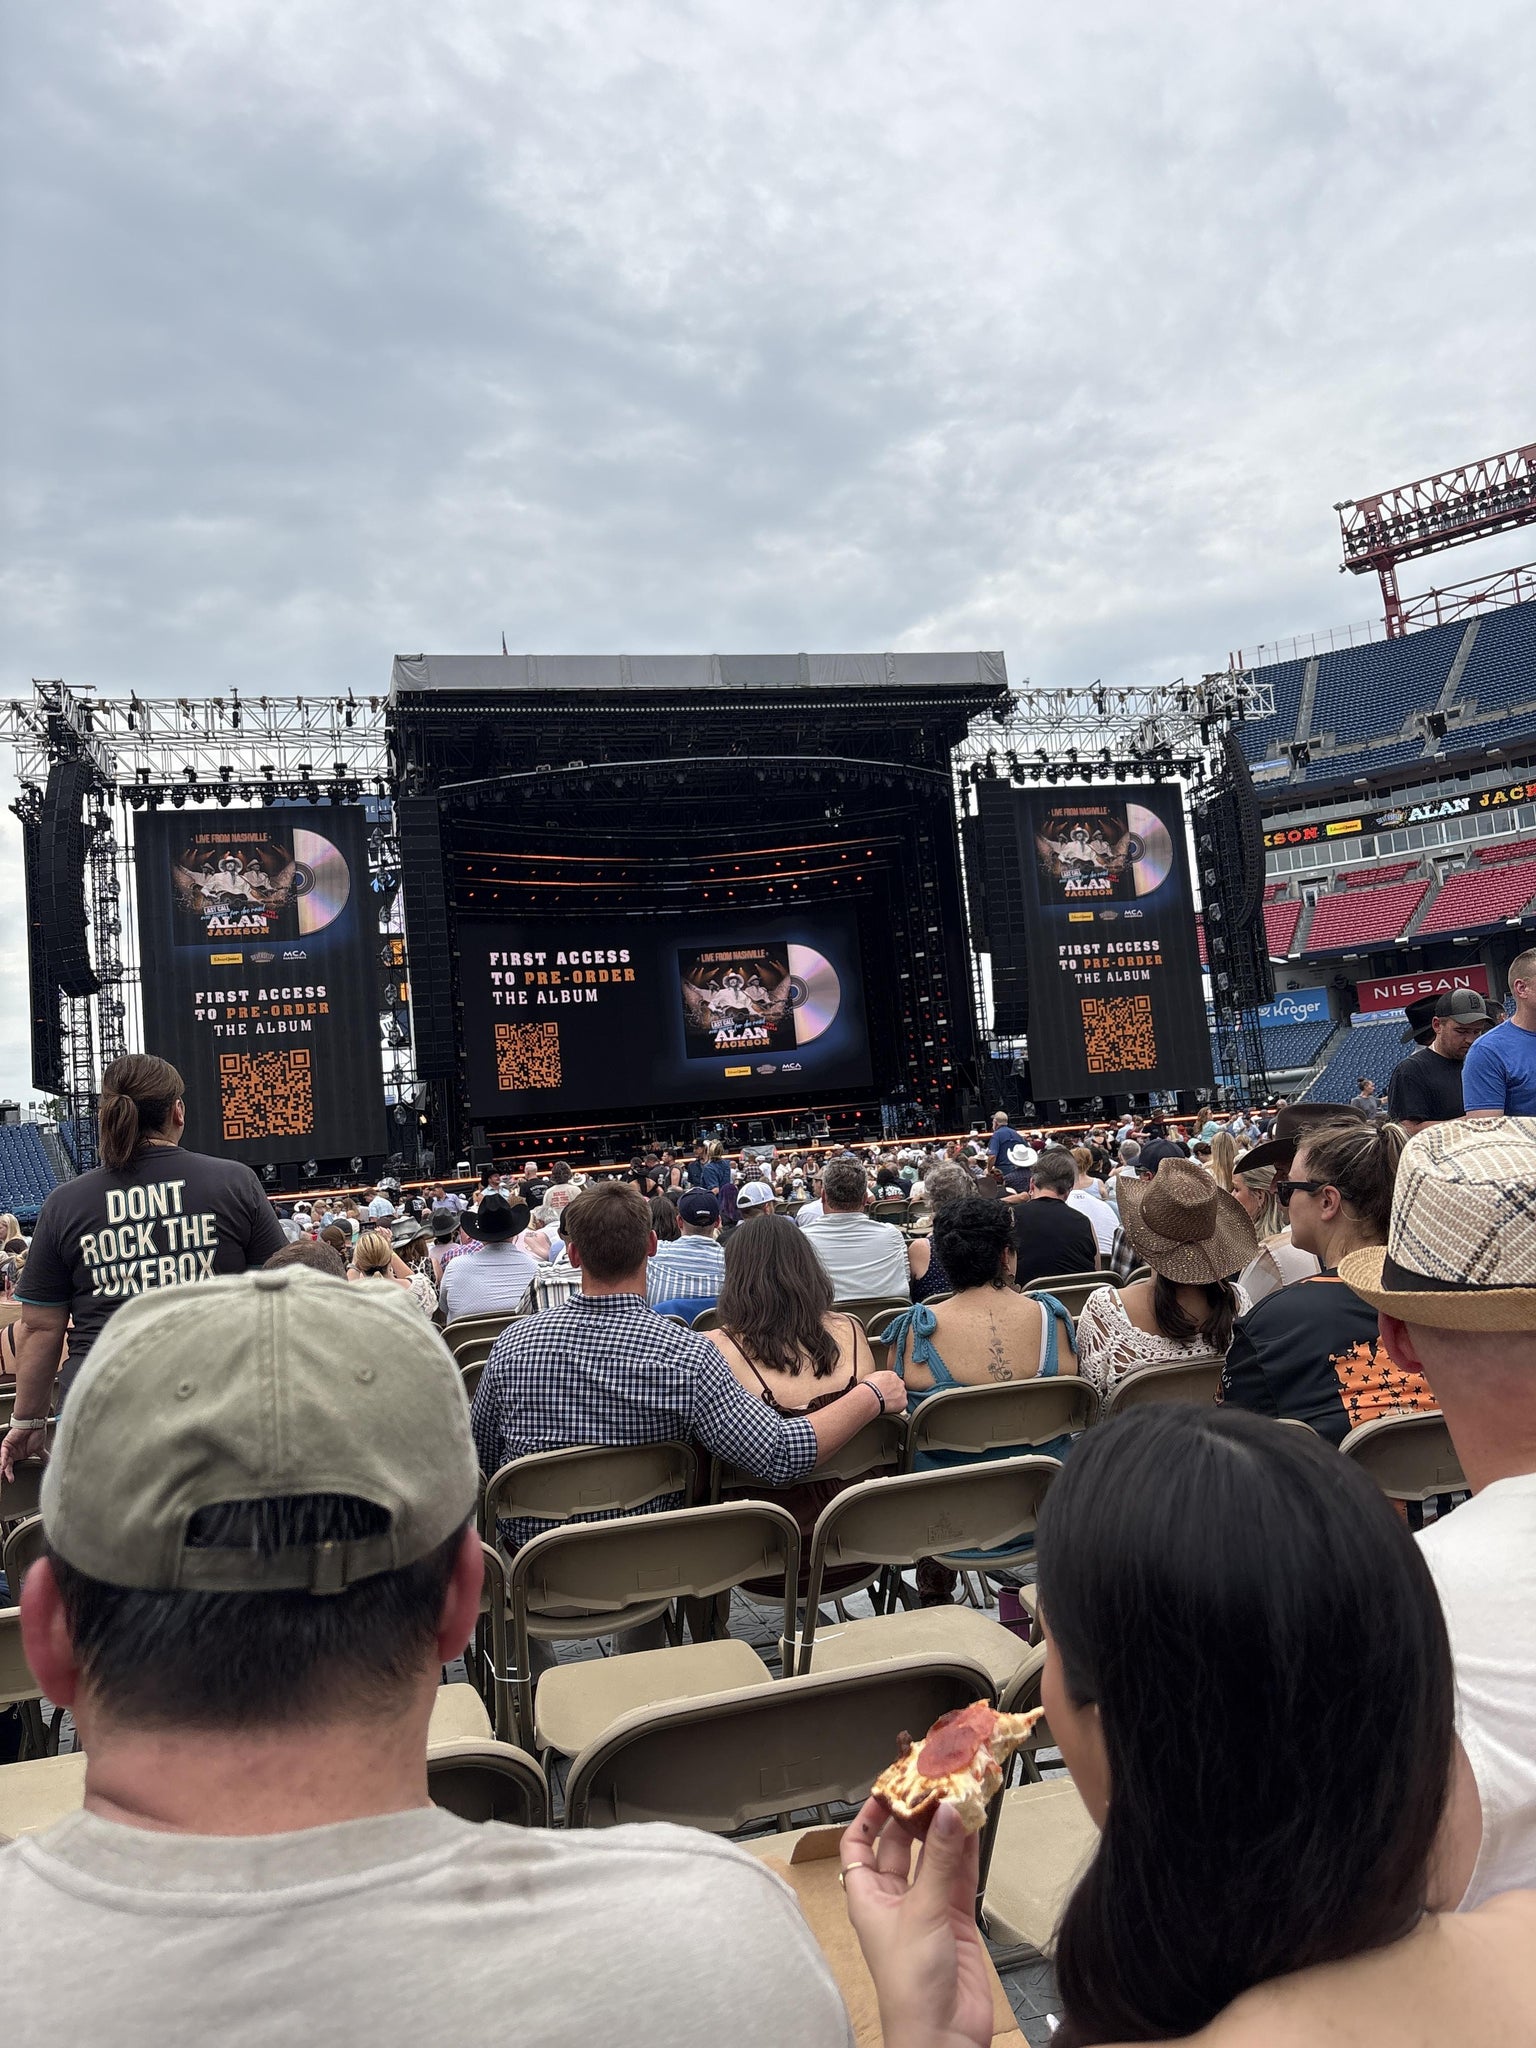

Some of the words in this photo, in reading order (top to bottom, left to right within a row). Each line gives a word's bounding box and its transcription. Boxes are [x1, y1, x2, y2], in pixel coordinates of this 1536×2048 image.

[1051, 808, 1063, 816] LIVE
[1064, 808, 1078, 816] FROM
[1408, 797, 1471, 822] ALAN
[195, 834, 210, 844] LIVE
[211, 833, 231, 844] FROM
[232, 832, 268, 842] NASHVILLE
[1064, 878, 1110, 890] ALAN
[1065, 889, 1113, 897] JACKSON
[207, 914, 268, 928] ALAN
[207, 926, 270, 936] JACKSON
[701, 953, 714, 962] LIVE
[715, 951, 732, 962] FROM
[732, 949, 766, 960] NASHVILLE
[1058, 943, 1100, 956] FIRST
[1106, 940, 1160, 954] ACCESS
[489, 952, 547, 966] FIRST
[556, 949, 631, 965] ACCESS
[1059, 960, 1077, 970] TO
[1083, 954, 1163, 970] PRE-ORDER
[490, 972, 516, 986] TO
[524, 968, 636, 985] PRE-ORDER
[1074, 973, 1100, 984] THE
[1106, 970, 1150, 983] ALBUM
[195, 989, 250, 1005] FIRST
[258, 985, 327, 1002] ACCESS
[1374, 974, 1471, 1000] NISSAN
[492, 990, 528, 1006] THE
[536, 988, 598, 1004] ALBUM
[194, 1008, 218, 1021] TO
[226, 1002, 330, 1019] PRE-ORDER
[1273, 998, 1321, 1022] Kroger
[214, 1022, 247, 1036] THE
[256, 1019, 312, 1034] ALBUM
[714, 1026, 768, 1042] ALAN
[714, 1038, 770, 1049] JACKSON
[105, 1179, 186, 1225] DONT
[80, 1221, 157, 1267] ROCK
[162, 1213, 217, 1252] THE
[91, 1248, 217, 1298] JUKEBOX
